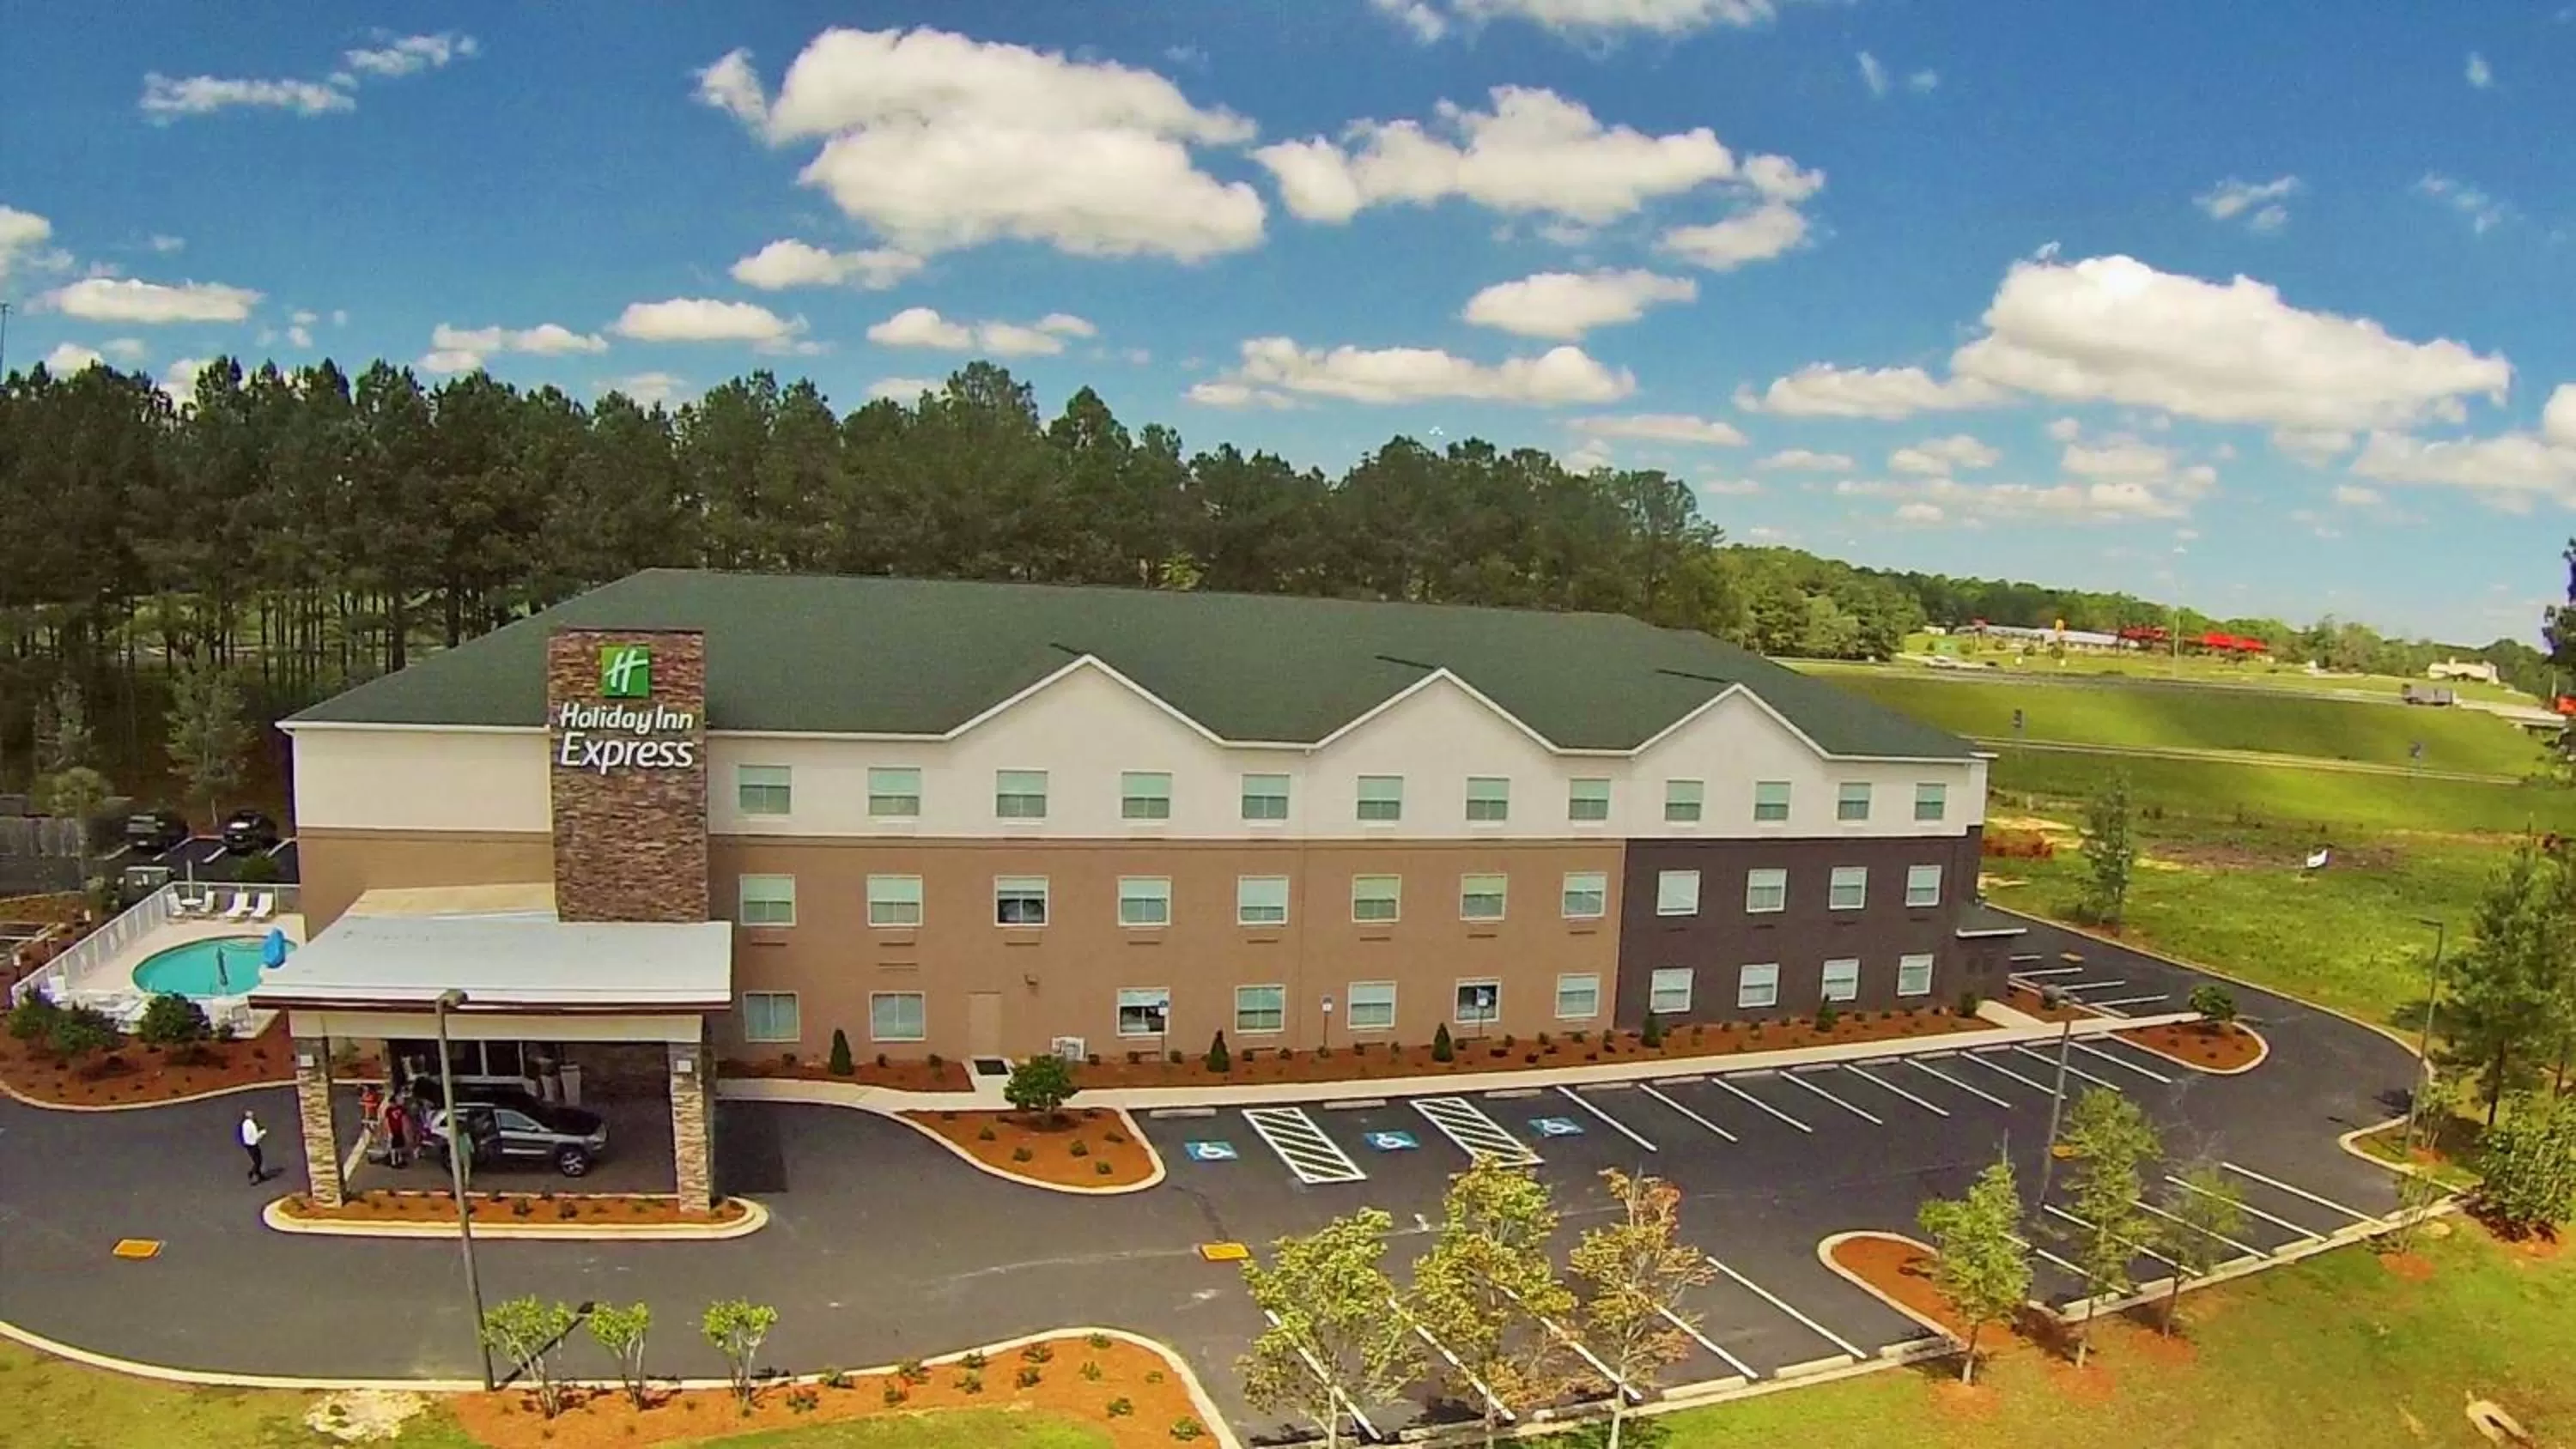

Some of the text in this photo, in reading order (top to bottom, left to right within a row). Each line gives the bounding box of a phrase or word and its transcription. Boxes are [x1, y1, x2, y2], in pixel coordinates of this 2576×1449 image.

[560, 702, 694, 734] Holiday Inn
[560, 731, 694, 775] Express
